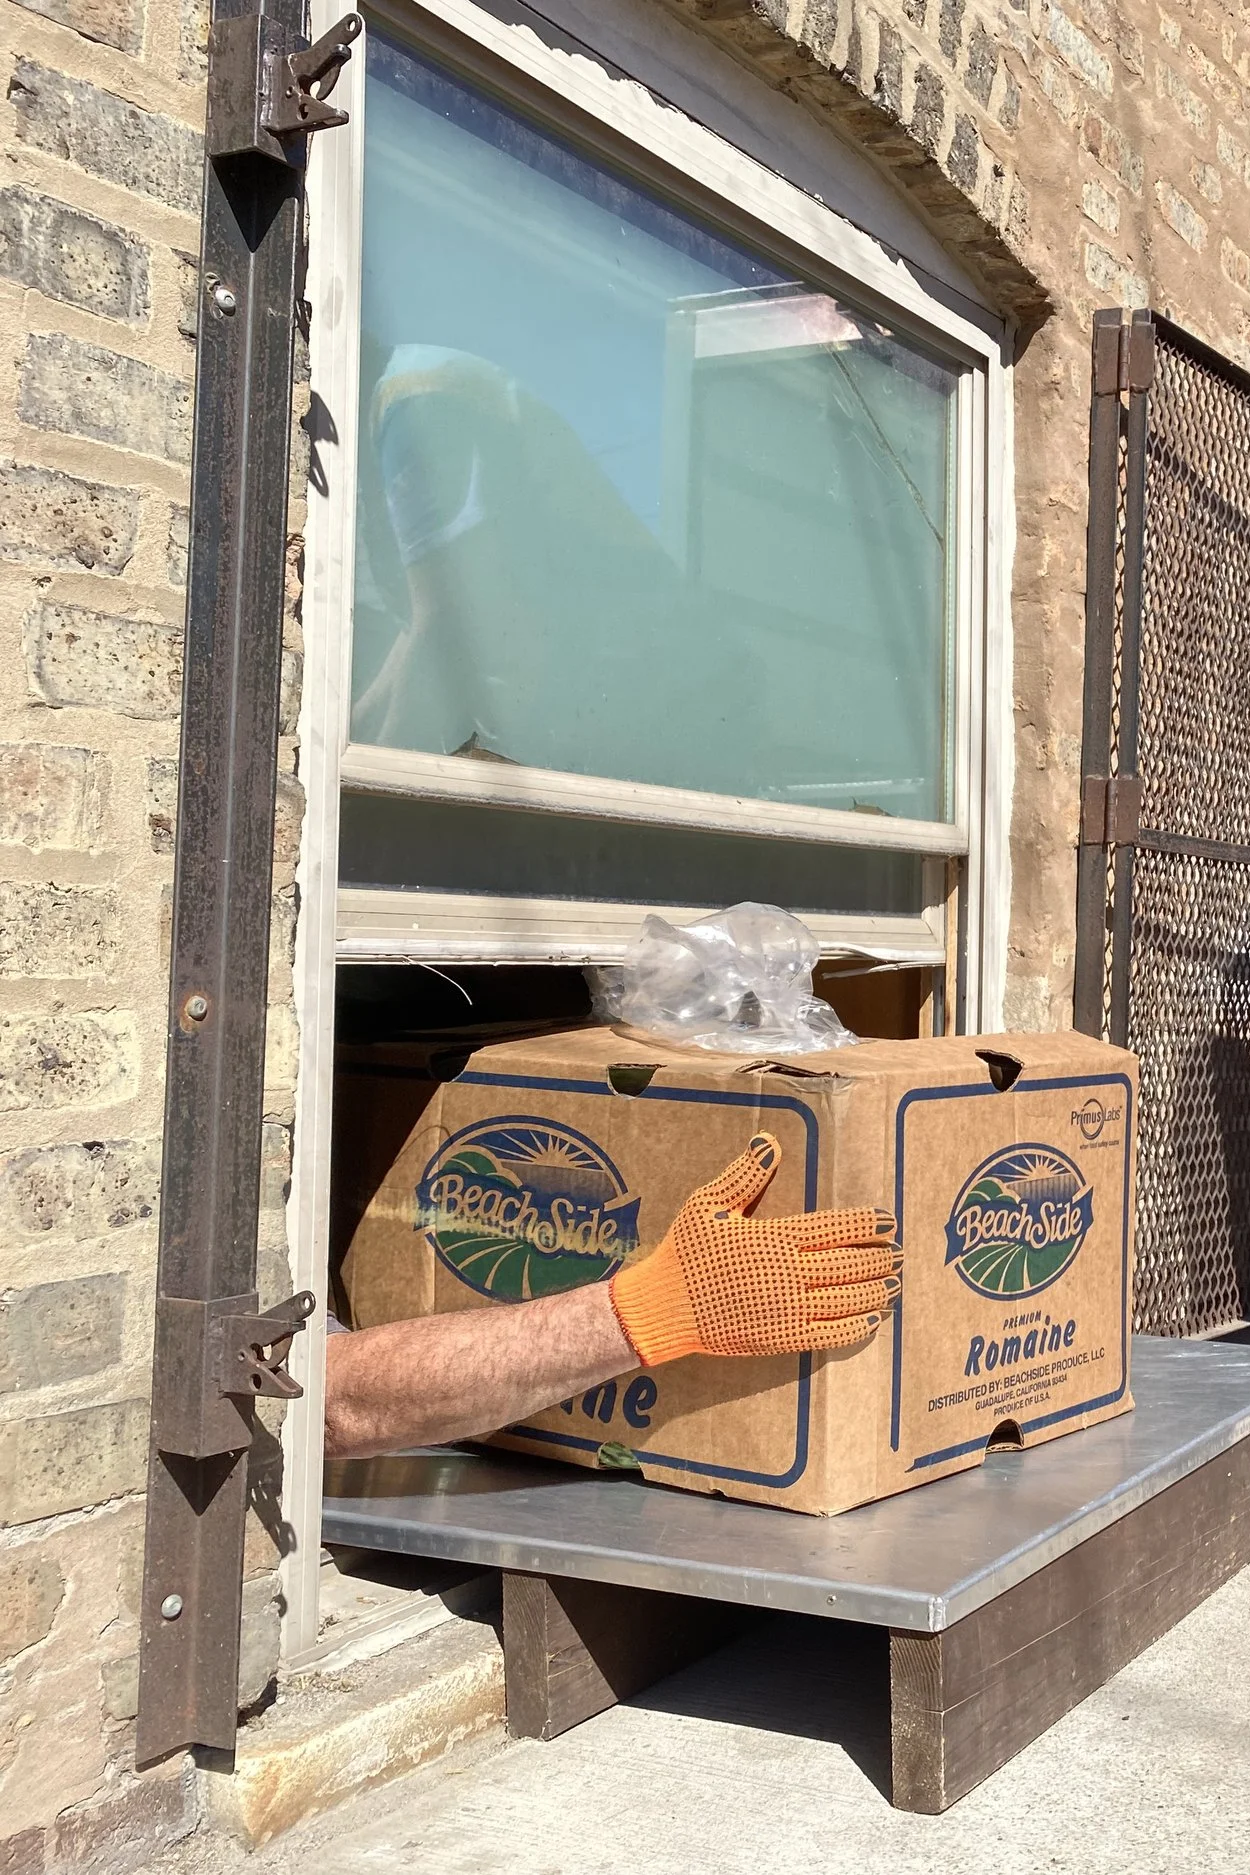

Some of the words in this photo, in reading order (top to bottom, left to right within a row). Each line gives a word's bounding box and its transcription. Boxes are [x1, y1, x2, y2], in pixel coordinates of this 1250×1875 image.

[1003, 1310, 1042, 1331] PREMIUM
[964, 1315, 1076, 1377] Romaine
[928, 1384, 987, 1413] DISTRIBUTED
[988, 1380, 1003, 1395] BY:
[1003, 1366, 1050, 1388] BEACHSIDE
[1051, 1354, 1090, 1374] PRODUCE,
[1091, 1347, 1105, 1361] LLC
[975, 1390, 1015, 1411] GUADALUPE,
[1015, 1379, 1051, 1397] CALIFORNIA
[993, 1401, 1024, 1417] PRODUCE
[1024, 1398, 1033, 1409] OF
